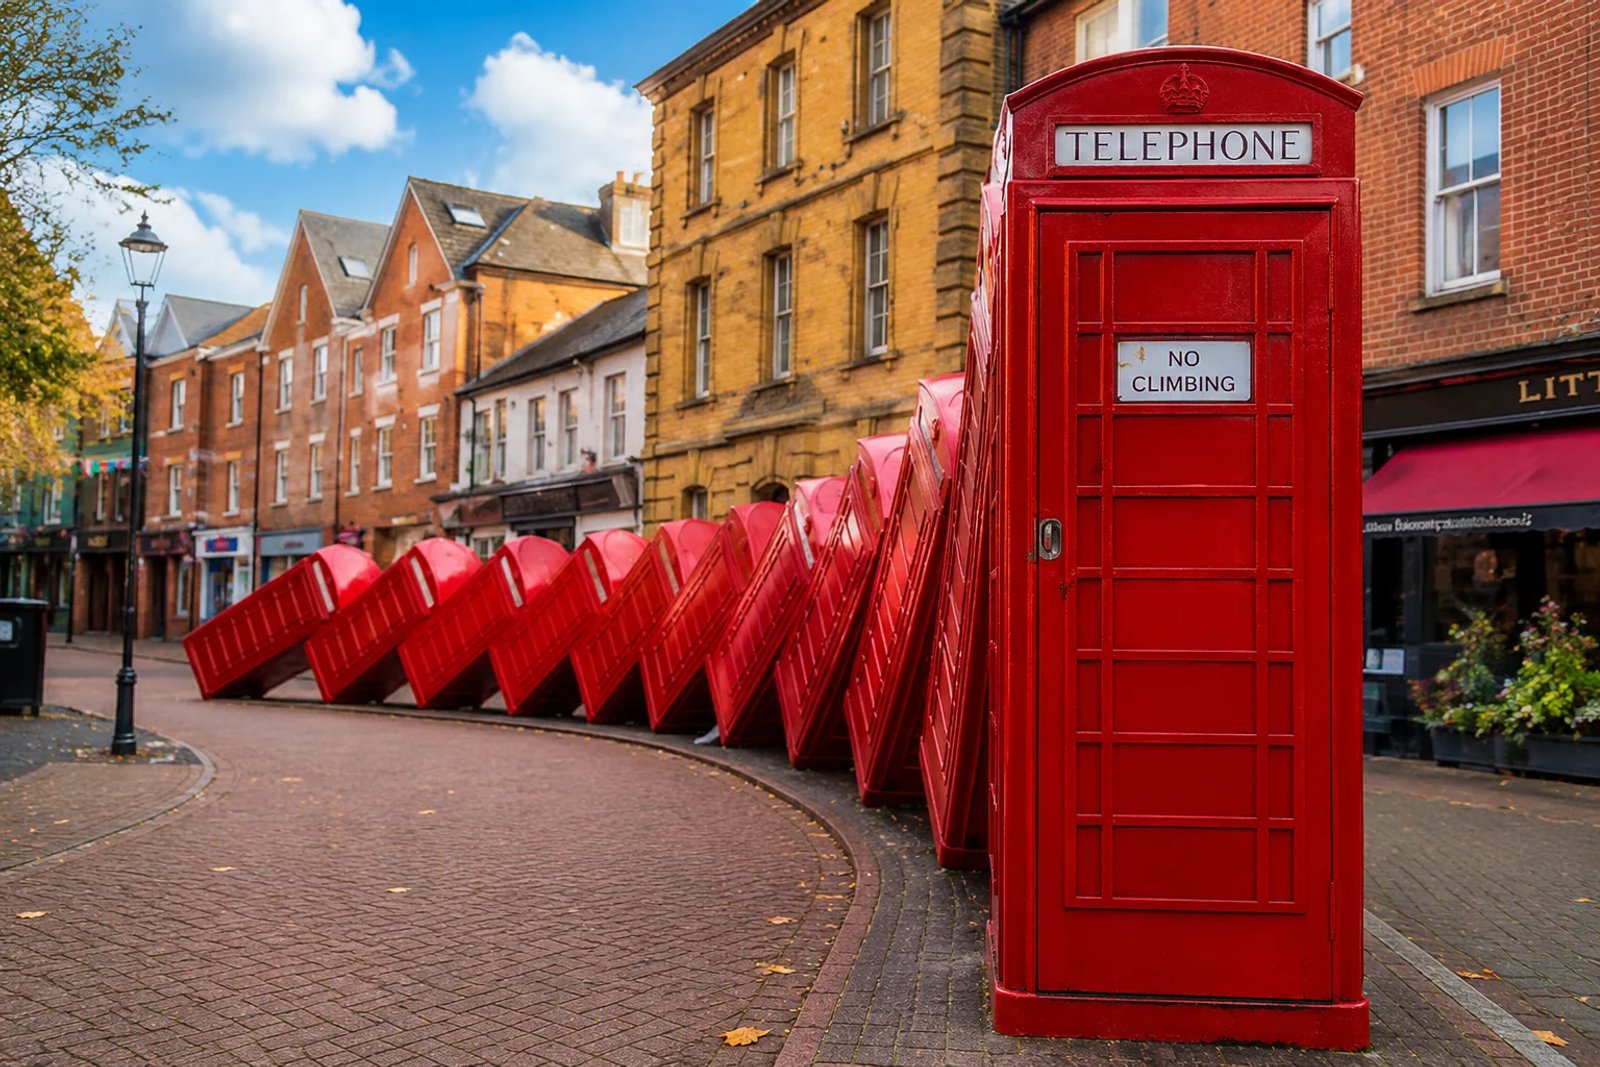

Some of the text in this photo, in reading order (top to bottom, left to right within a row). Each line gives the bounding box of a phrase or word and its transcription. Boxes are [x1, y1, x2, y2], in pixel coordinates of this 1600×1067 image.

[1065, 130, 1300, 161] TELEPHONE
[1168, 350, 1200, 367] NO
[1132, 375, 1235, 392] CLIMBING
